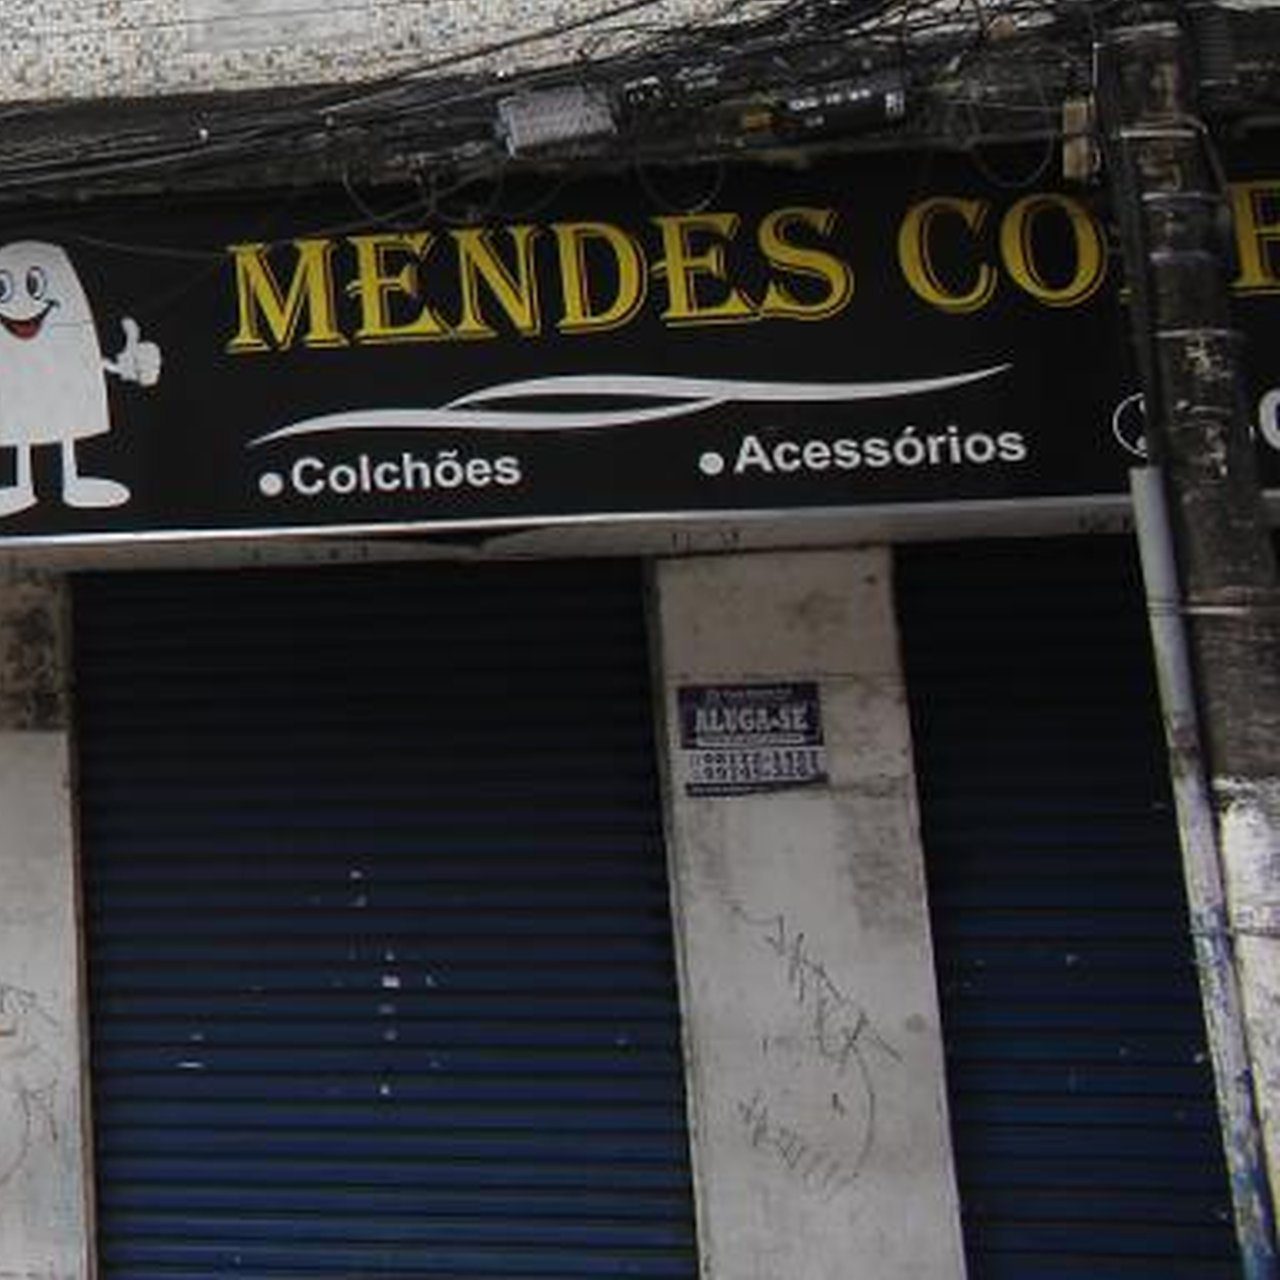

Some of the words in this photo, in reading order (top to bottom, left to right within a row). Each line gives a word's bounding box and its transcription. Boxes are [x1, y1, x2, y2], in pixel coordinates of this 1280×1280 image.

[228, 204, 855, 353] MENDES
[290, 447, 522, 498] Colchões
[733, 423, 1027, 477] Acessórios
[695, 701, 809, 732] ALUGA-SE
